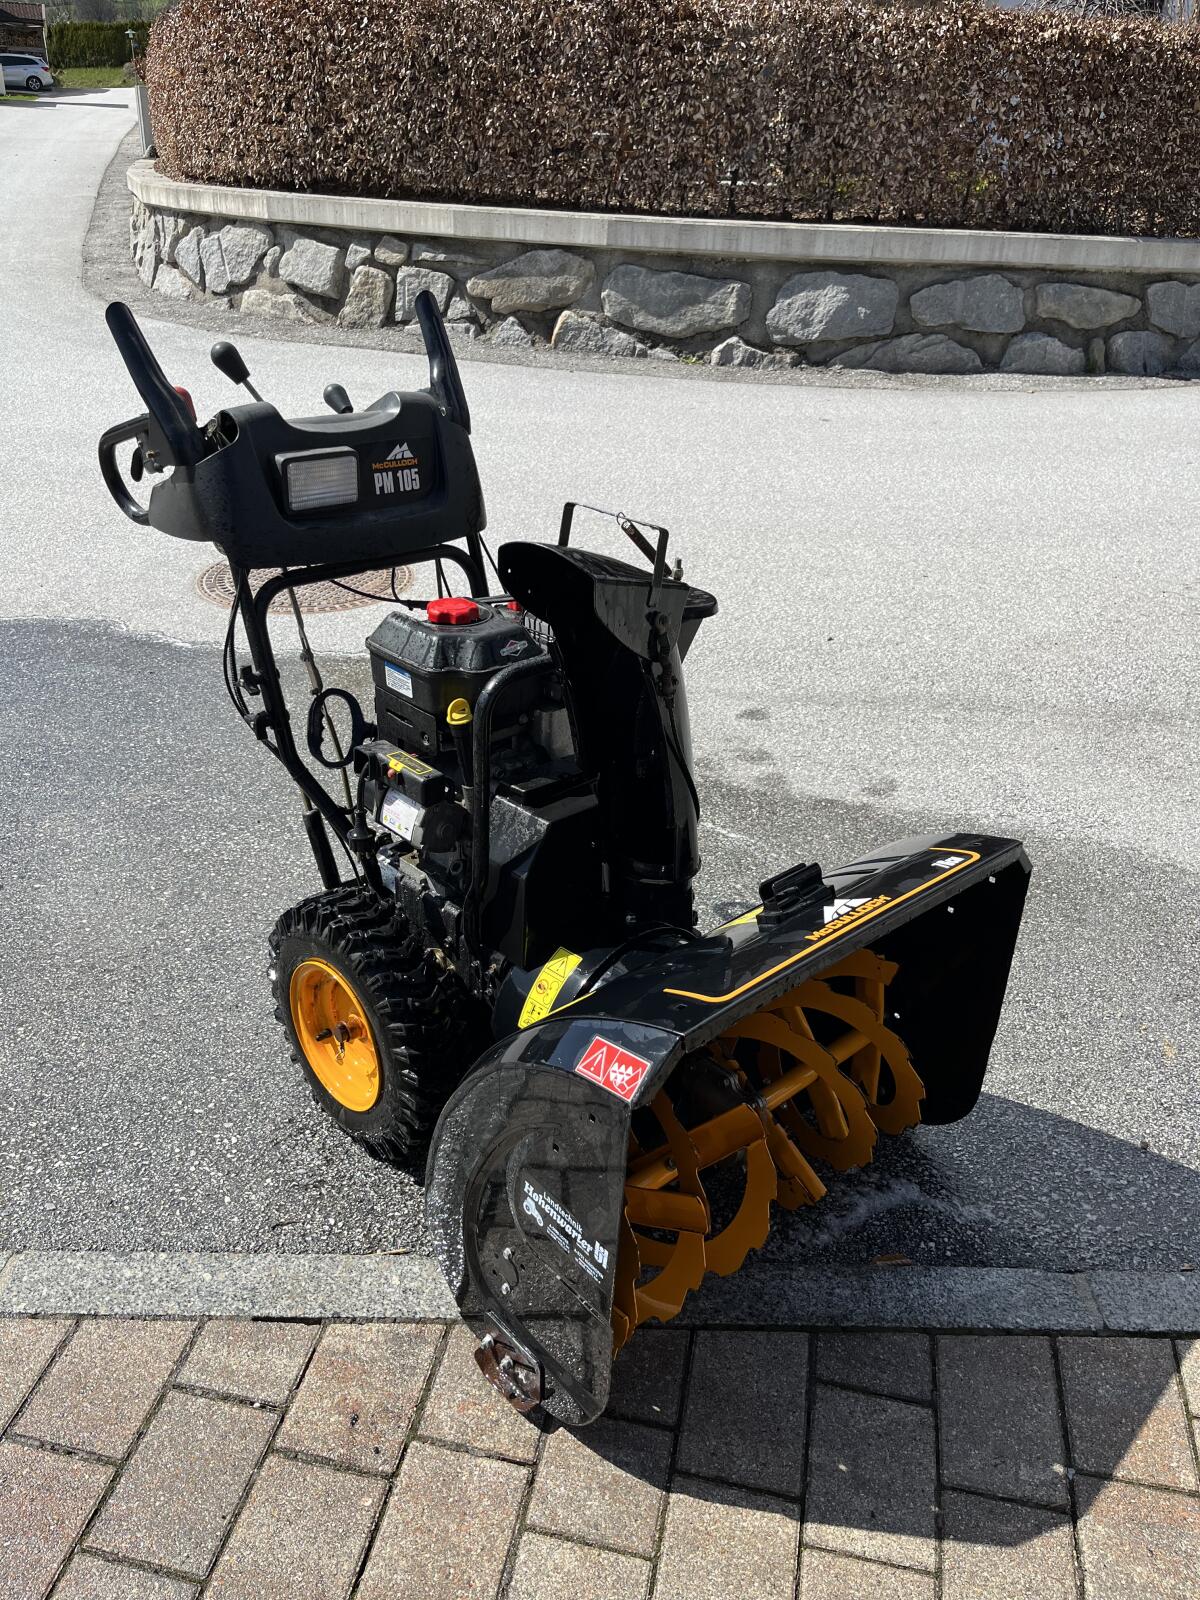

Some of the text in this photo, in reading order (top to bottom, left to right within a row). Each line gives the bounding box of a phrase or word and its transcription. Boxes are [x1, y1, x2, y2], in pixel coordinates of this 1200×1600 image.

[373, 468, 420, 495] PM 105
[523, 1180, 593, 1253] Hohenwarter
[543, 1191, 583, 1235] Landtechnik
